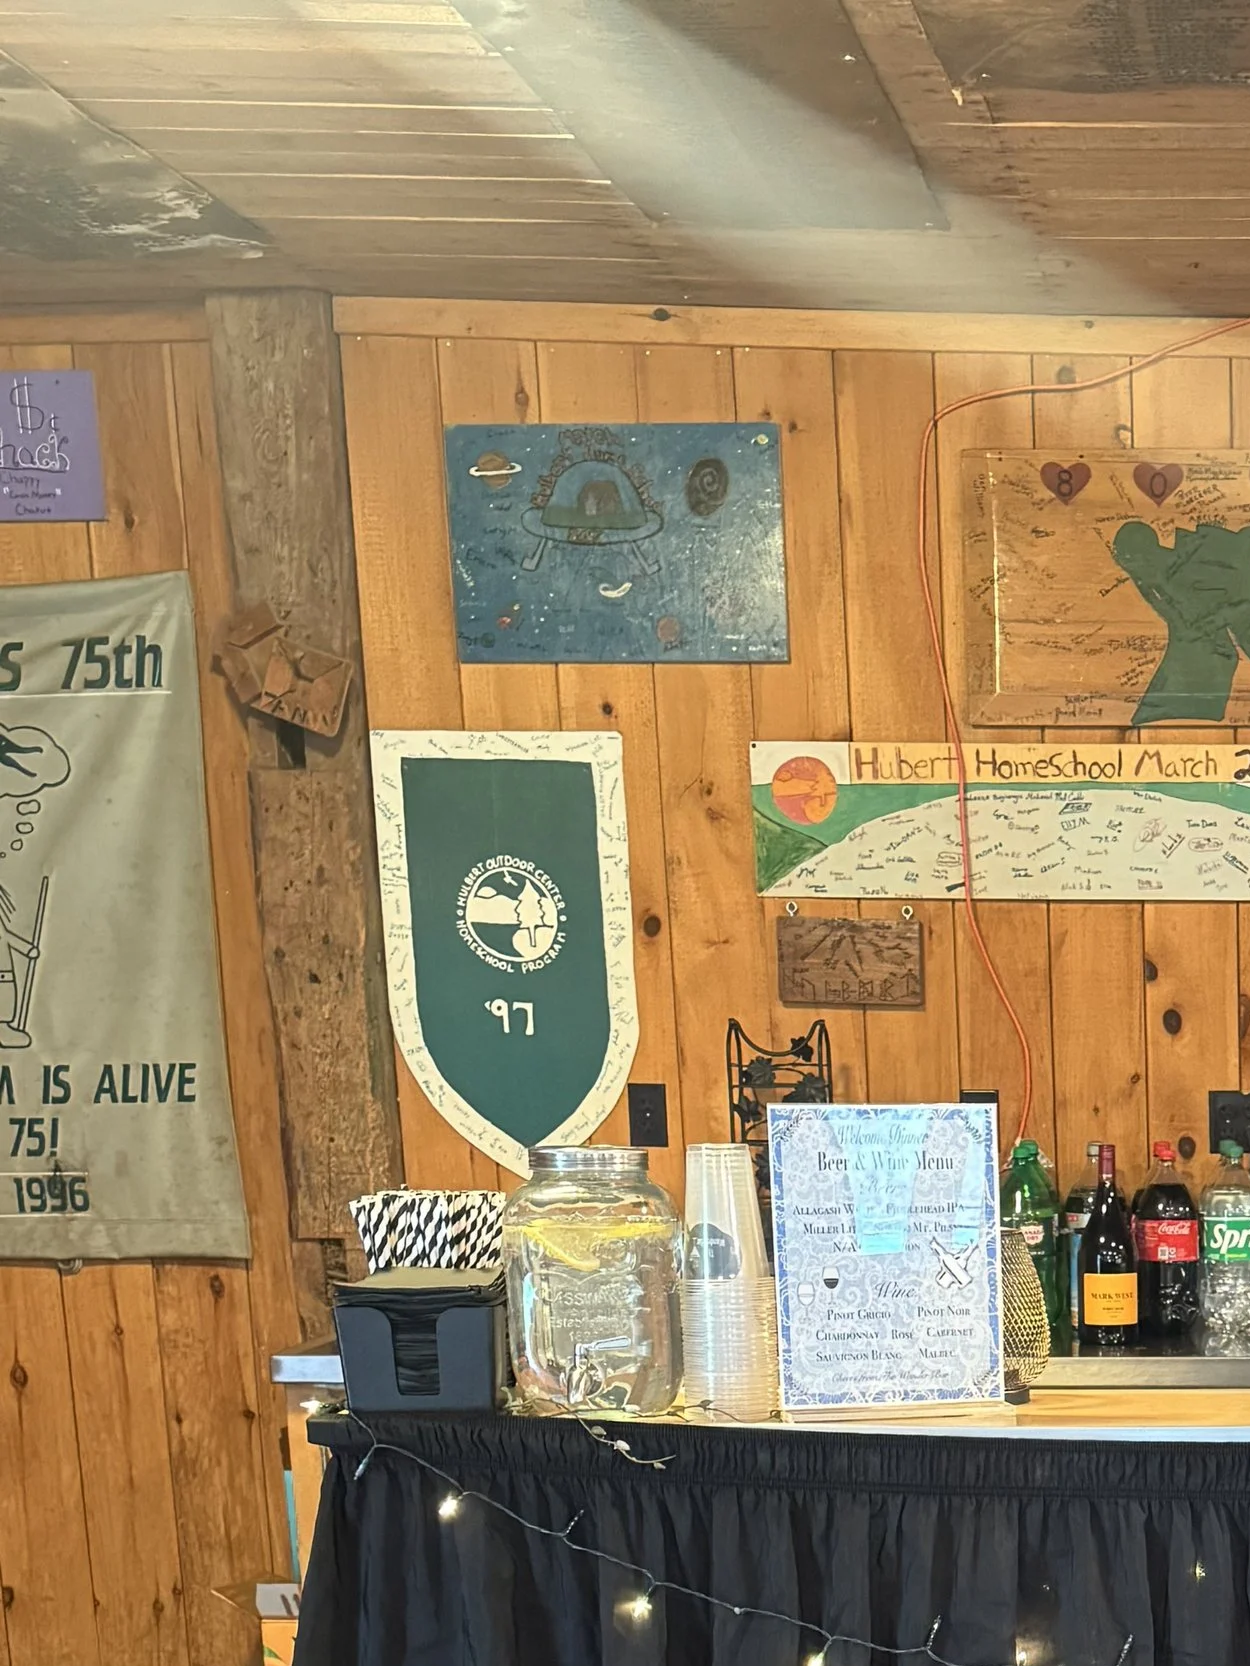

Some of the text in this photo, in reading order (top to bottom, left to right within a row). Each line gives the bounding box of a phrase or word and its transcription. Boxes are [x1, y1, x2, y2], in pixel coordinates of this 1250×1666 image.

[61, 635, 163, 690] 75th
[975, 747, 1123, 780] HomeSchool
[1134, 749, 1218, 779] March
[486, 855, 535, 872] OUTDOOR
[457, 862, 485, 907] HULBERT
[534, 869, 566, 910] CENTER
[456, 920, 567, 974] HOMESCHOOL PROGRAM
[42, 1065, 71, 1104] IS
[93, 1062, 197, 1104] ALIVE
[9, 1117, 59, 1157] 75!
[889, 1123, 928, 1145] Dinner
[818, 1151, 849, 1171] Beer
[915, 1151, 954, 1171] Menu
[13, 1176, 90, 1213] 1996
[874, 1281, 917, 1298] Wine
